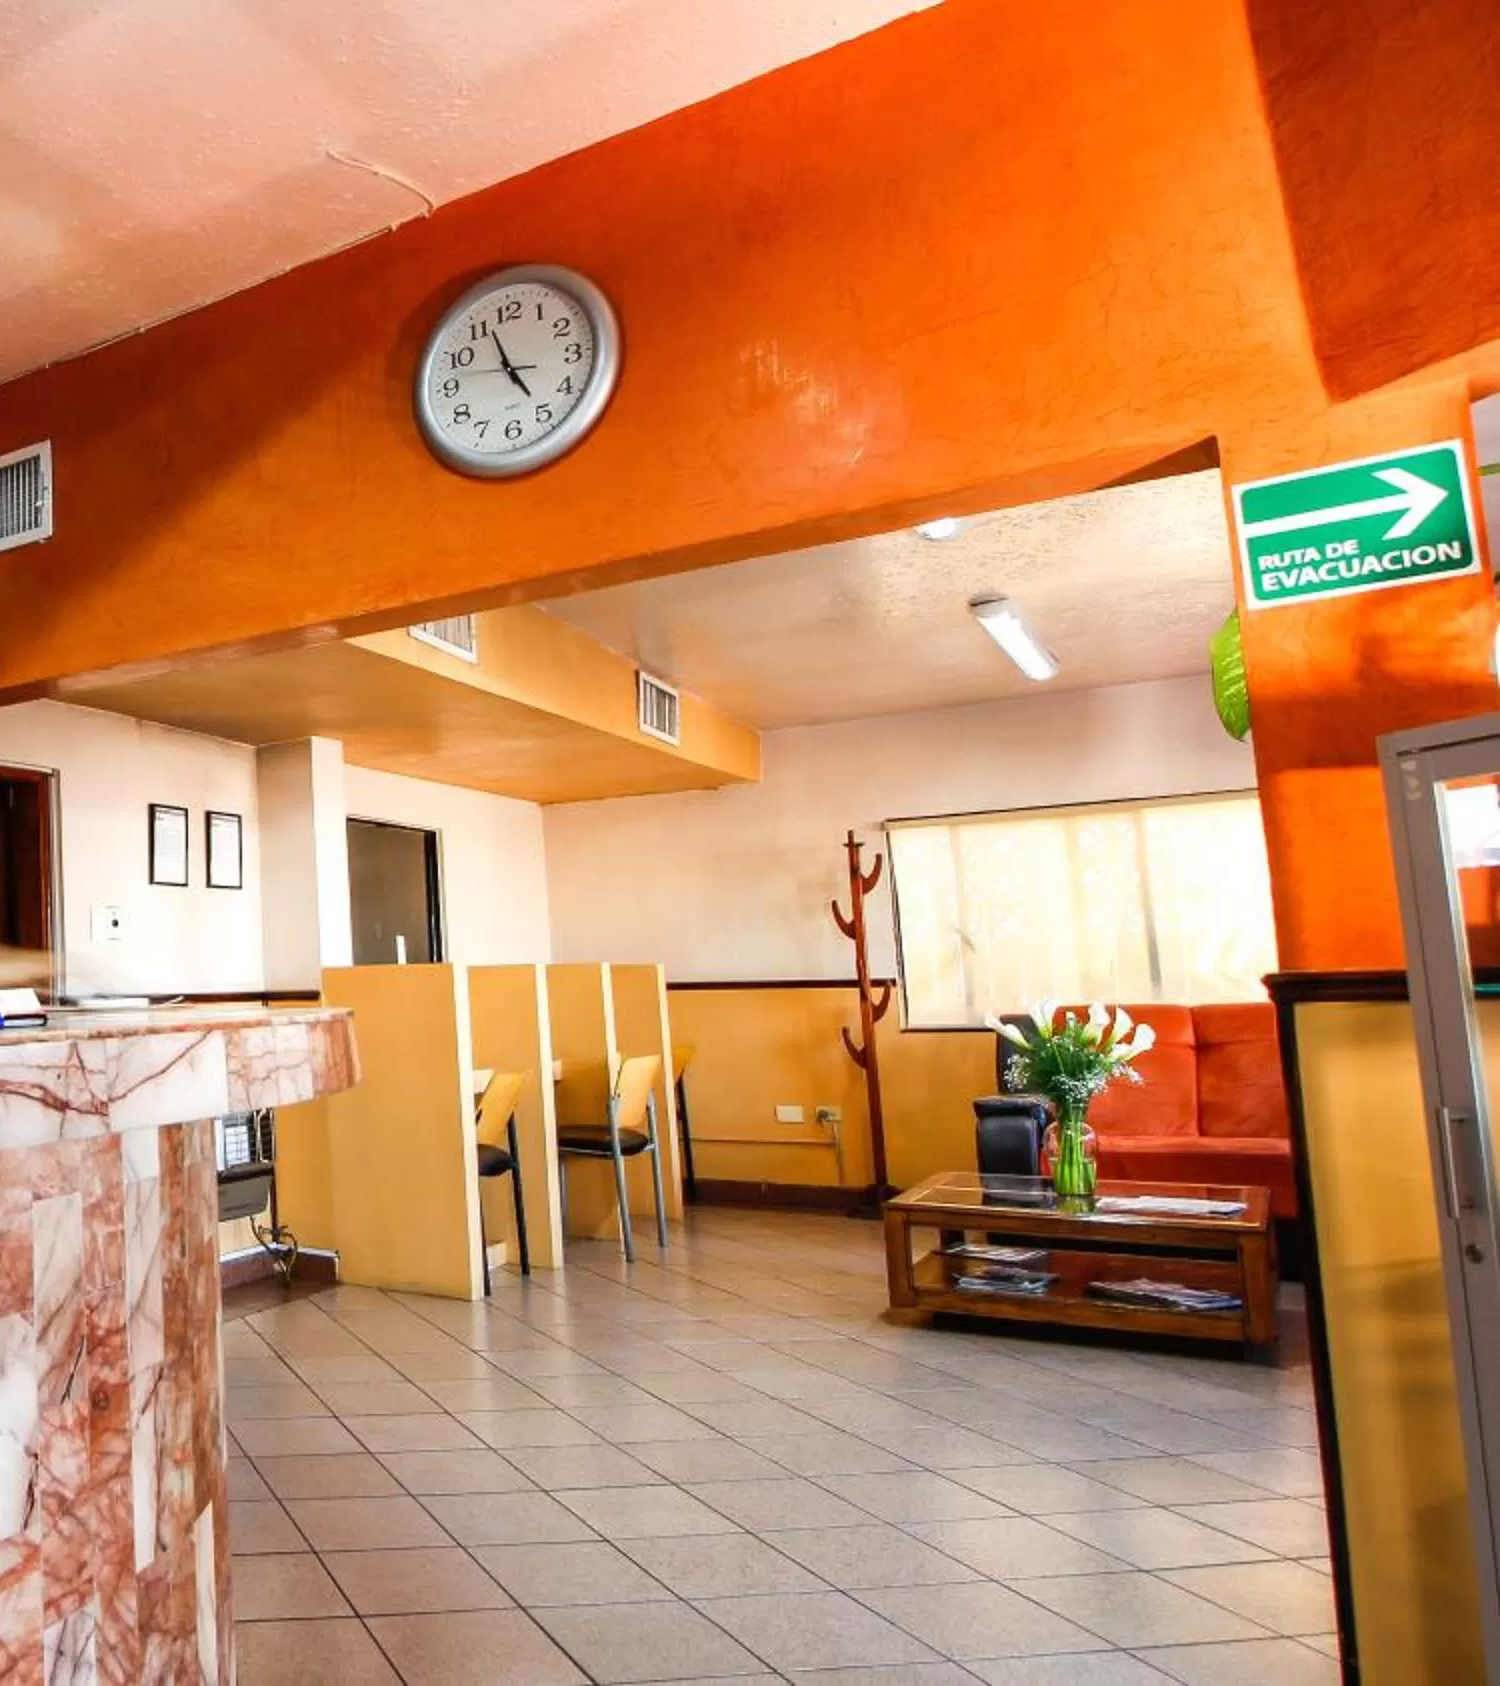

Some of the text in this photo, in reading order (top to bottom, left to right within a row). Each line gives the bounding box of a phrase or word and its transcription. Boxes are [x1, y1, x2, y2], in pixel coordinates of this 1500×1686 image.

[495, 301, 521, 324] 12
[535, 303, 543, 321] 1
[469, 320, 488, 340] 11
[553, 317, 570, 338] 2
[450, 347, 474, 369] 10
[564, 343, 582, 364] 3
[443, 379, 459, 397] 9
[556, 376, 572, 395] 4
[453, 404, 471, 424] 8
[535, 403, 552, 423] 5
[474, 420, 489, 439] 7
[505, 420, 522, 440] 6
[1258, 540, 1359, 570] RUTA DE
[1261, 541, 1461, 591] EVACUACION
